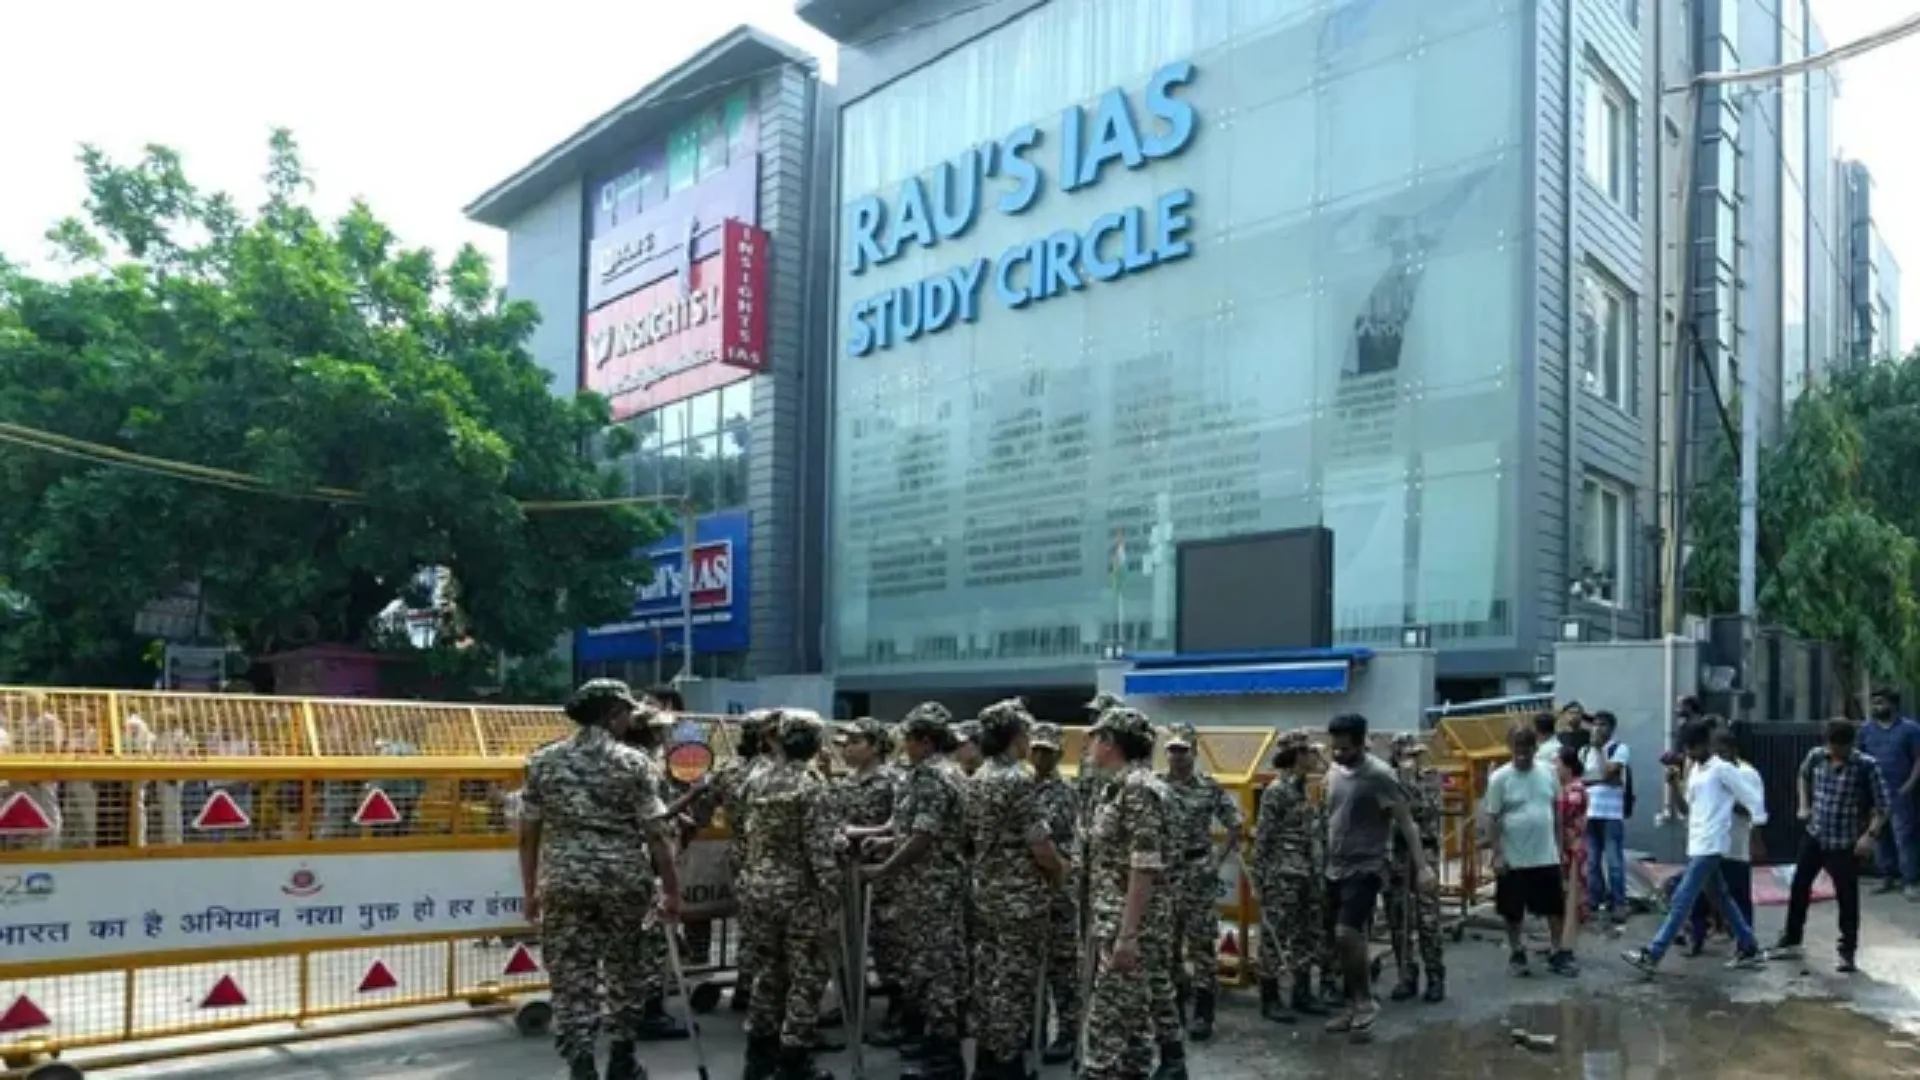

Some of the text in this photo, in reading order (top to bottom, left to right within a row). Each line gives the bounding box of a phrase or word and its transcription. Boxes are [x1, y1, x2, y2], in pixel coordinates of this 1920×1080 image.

[847, 59, 1200, 276] RAU'S IAS
[737, 227, 755, 344] INSIGHTS
[846, 187, 1195, 358] STUDY CIRCLE
[728, 345, 761, 364] IAS
[88, 918, 128, 940] का
[143, 909, 164, 938] है
[180, 905, 281, 934] अभियान
[296, 903, 344, 926] नशा
[358, 901, 400, 931] मुक्त
[412, 893, 437, 921] हो
[449, 897, 474, 919] हर
[485, 890, 526, 917] इंसा
